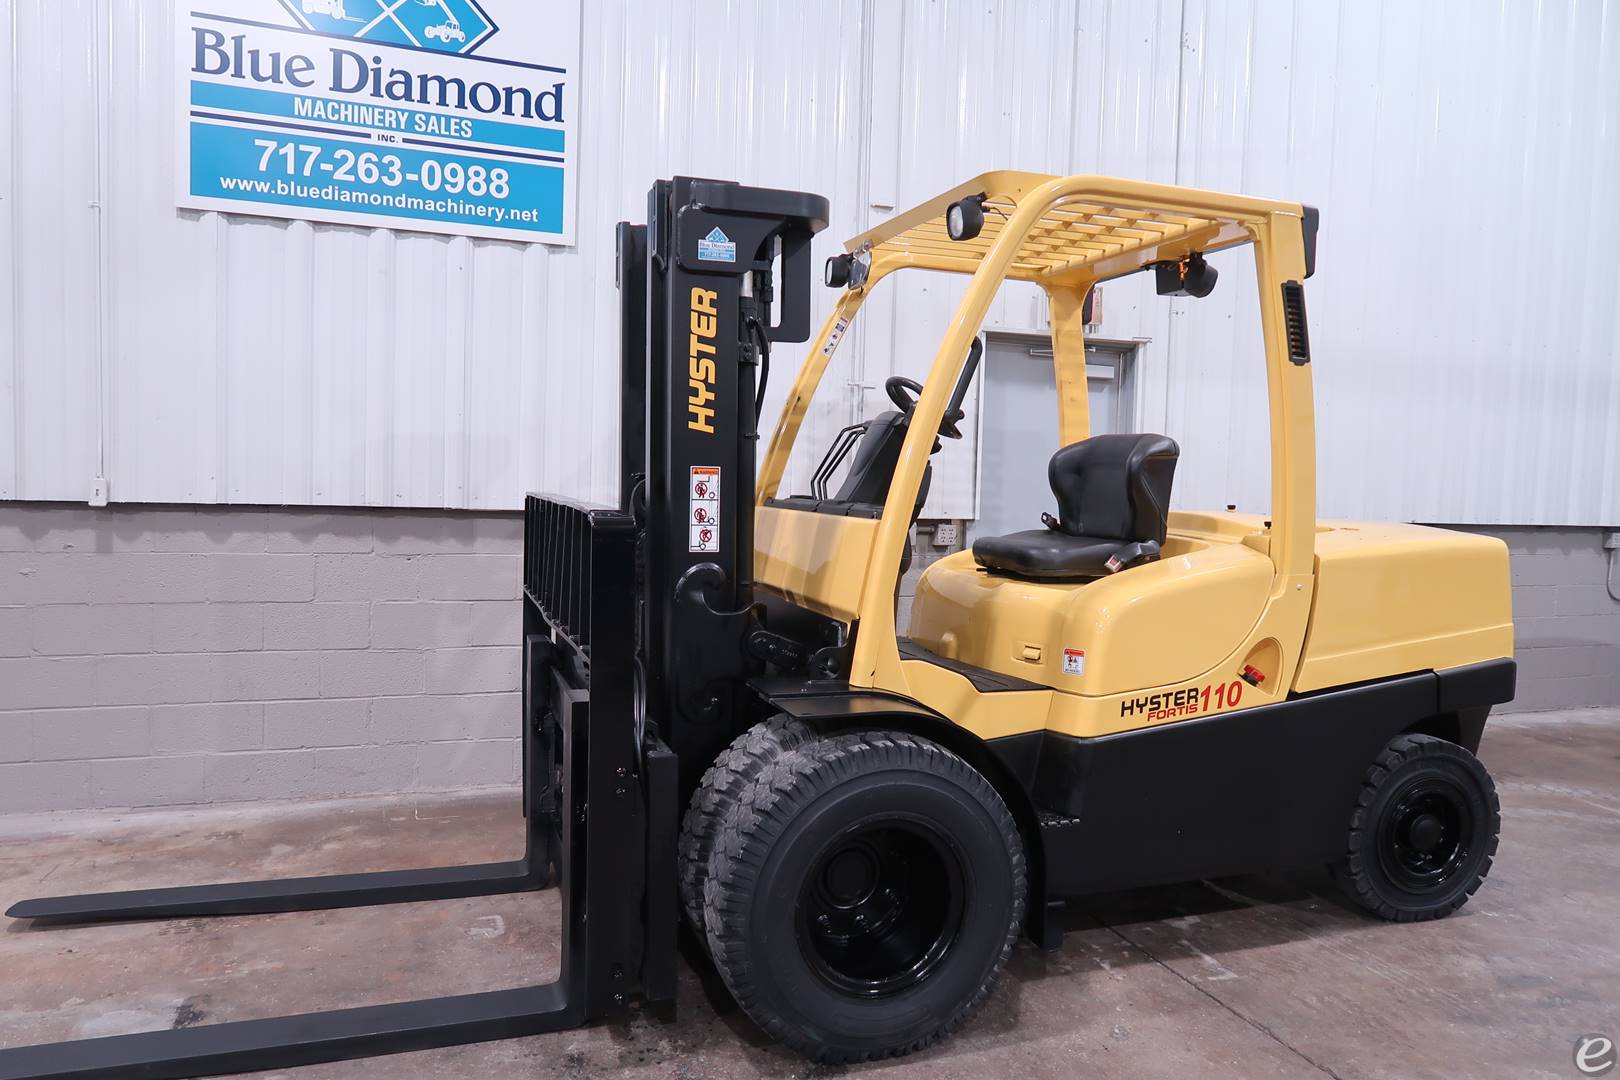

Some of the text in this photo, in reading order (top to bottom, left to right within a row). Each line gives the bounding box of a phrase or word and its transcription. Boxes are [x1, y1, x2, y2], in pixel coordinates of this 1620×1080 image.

[191, 27, 565, 123] Blue Diamond
[293, 97, 473, 138] MACHINERY SALES
[376, 133, 399, 144] INC.
[253, 138, 510, 199] 717-263-0988
[219, 175, 539, 223] www.bluediamondmachinery.net
[688, 286, 718, 434] HYSTER
[1121, 680, 1243, 716] HYSTER 110
[1147, 703, 1198, 722] FORTIS
